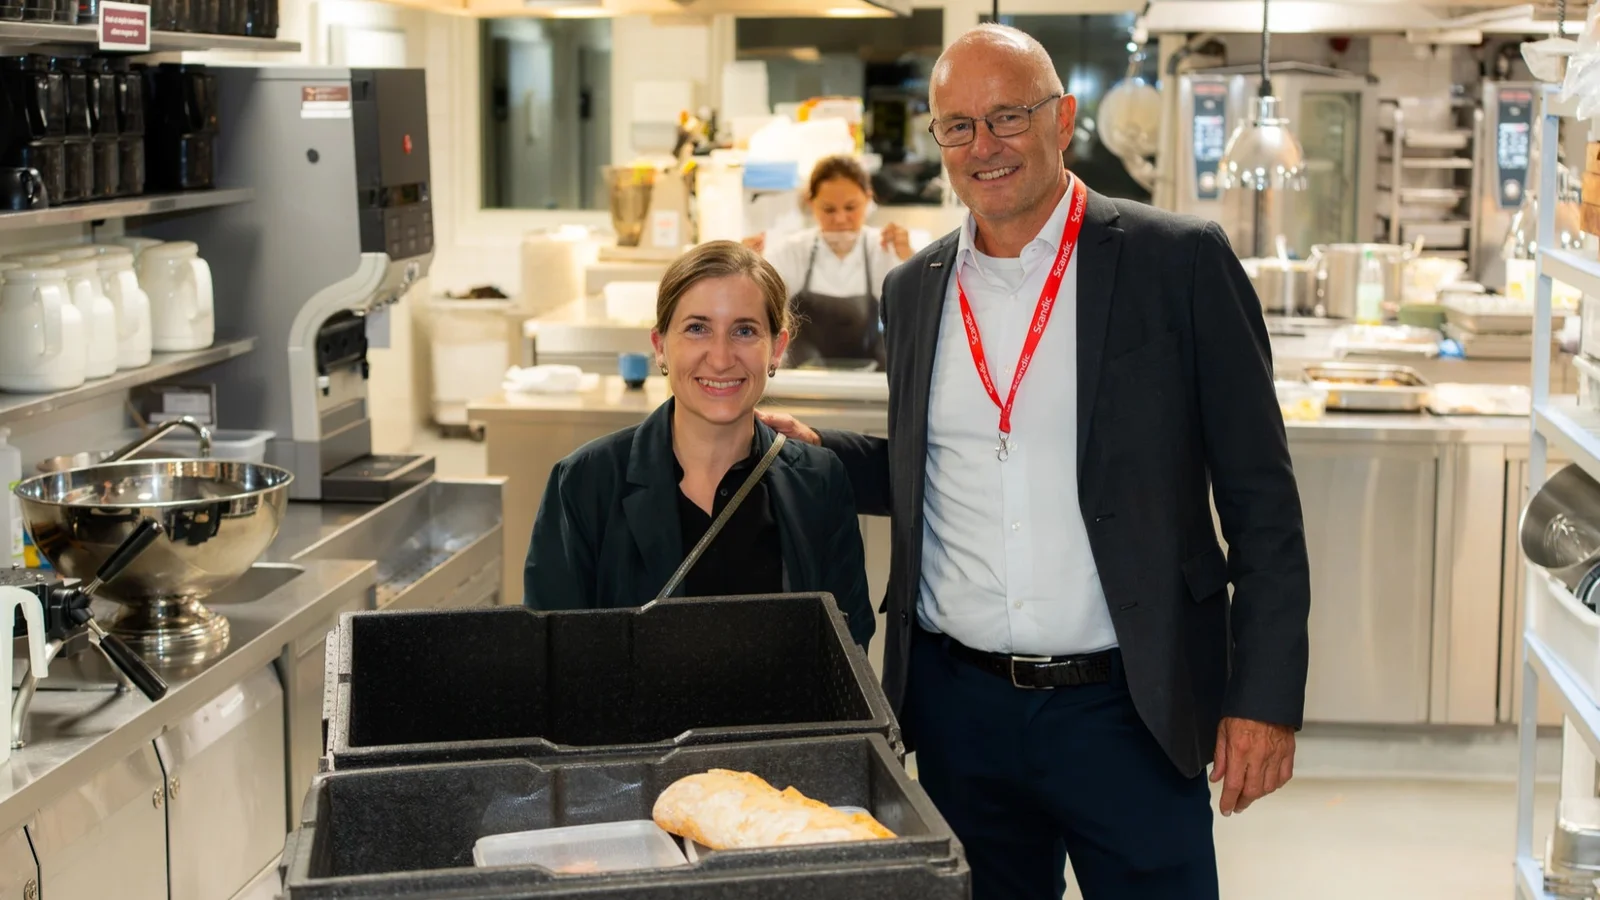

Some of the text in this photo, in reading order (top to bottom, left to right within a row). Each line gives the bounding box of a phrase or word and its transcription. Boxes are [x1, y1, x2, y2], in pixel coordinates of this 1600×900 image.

[1071, 192, 1085, 223] Scandic
[1053, 240, 1073, 278] Scandic
[965, 311, 979, 345] Scandic
[1033, 296, 1052, 334] Scandic
[978, 359, 994, 394] Scandic
